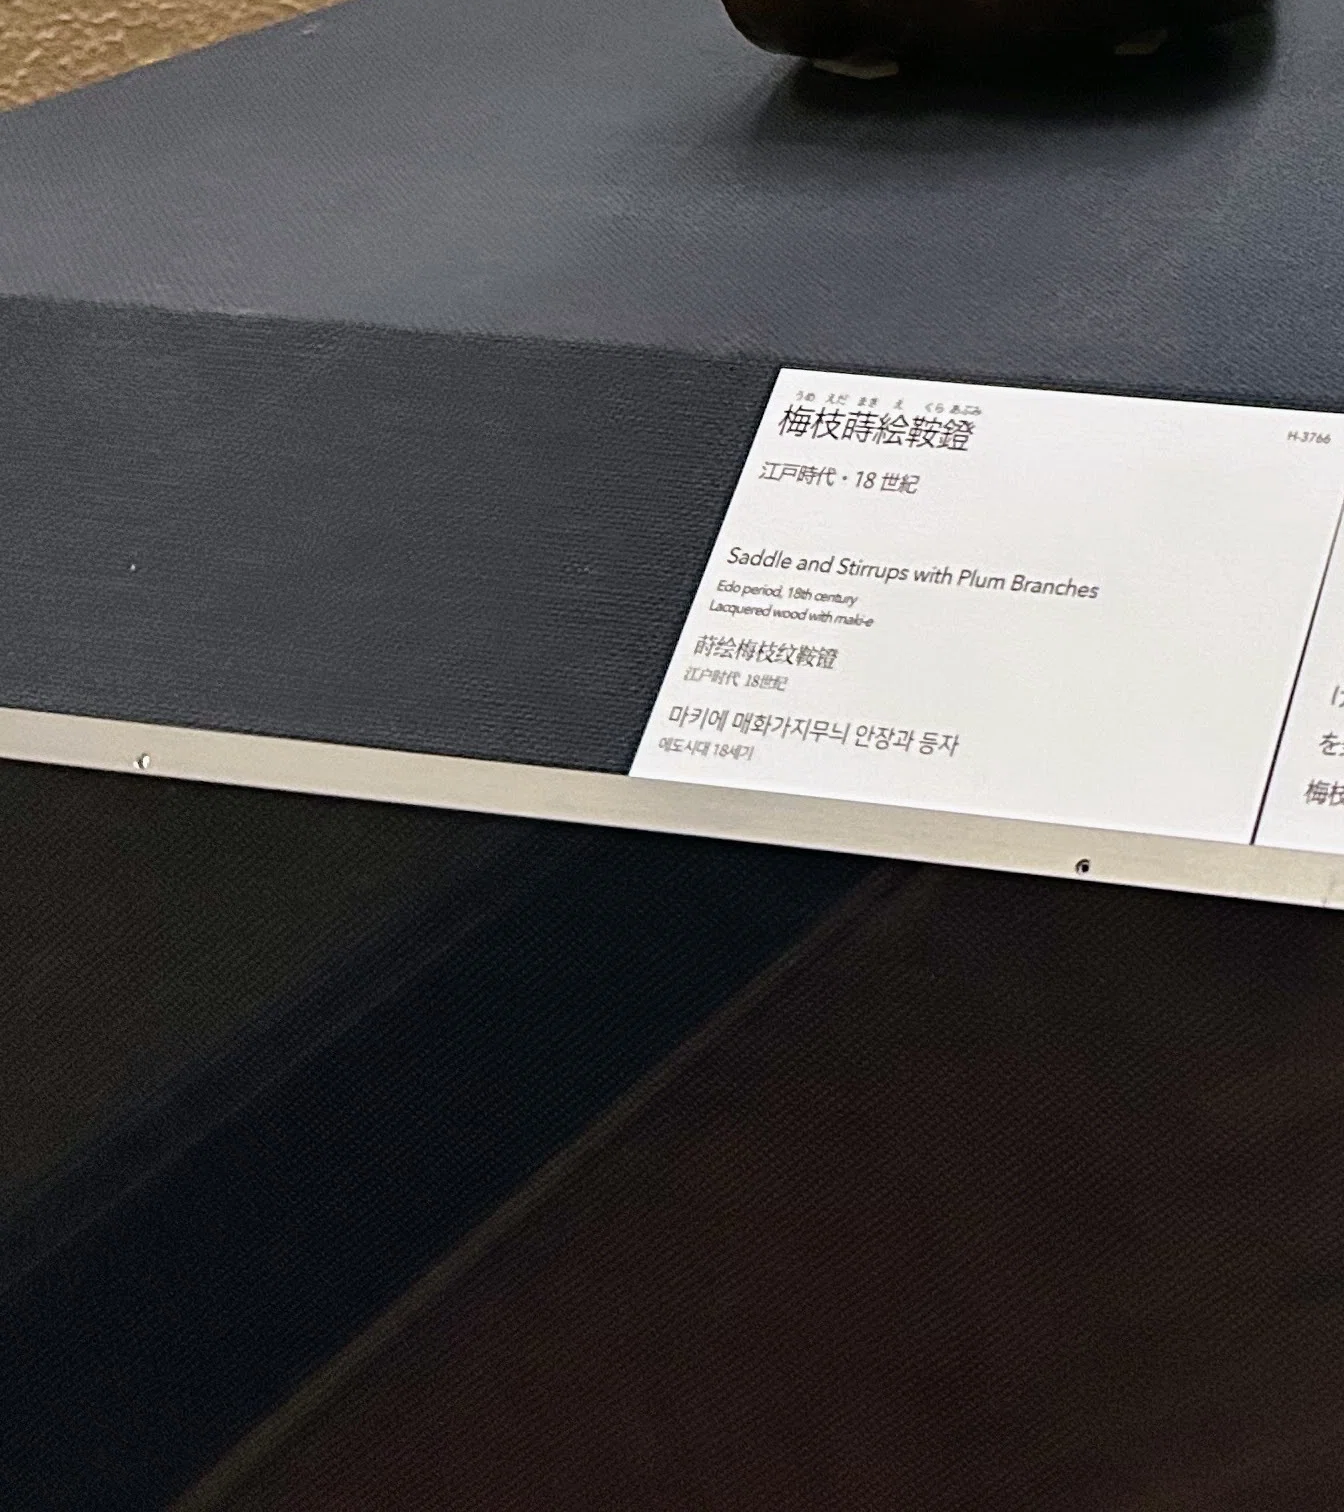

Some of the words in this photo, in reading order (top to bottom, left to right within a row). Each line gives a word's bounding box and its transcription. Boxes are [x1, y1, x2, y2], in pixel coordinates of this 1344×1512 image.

[778, 404, 974, 452] 梅枝蒔絵鞍鐙
[1287, 431, 1332, 445] H-3766
[726, 546, 793, 570] Saddle
[795, 555, 836, 574] and
[836, 557, 910, 585] Stirrups
[914, 566, 953, 585] with
[956, 569, 1006, 590] Plum
[1010, 574, 1100, 599] Branches
[708, 599, 773, 617] Lacquered
[772, 608, 809, 621] wood
[808, 610, 833, 623] with
[716, 579, 742, 594] Edo
[740, 585, 784, 599] period,
[788, 586, 813, 601] 18th
[813, 592, 859, 608] century
[668, 705, 730, 733] 마키에
[731, 712, 851, 745] 매화가지무늬
[854, 724, 915, 752] 안장과
[918, 731, 960, 757] 등자
